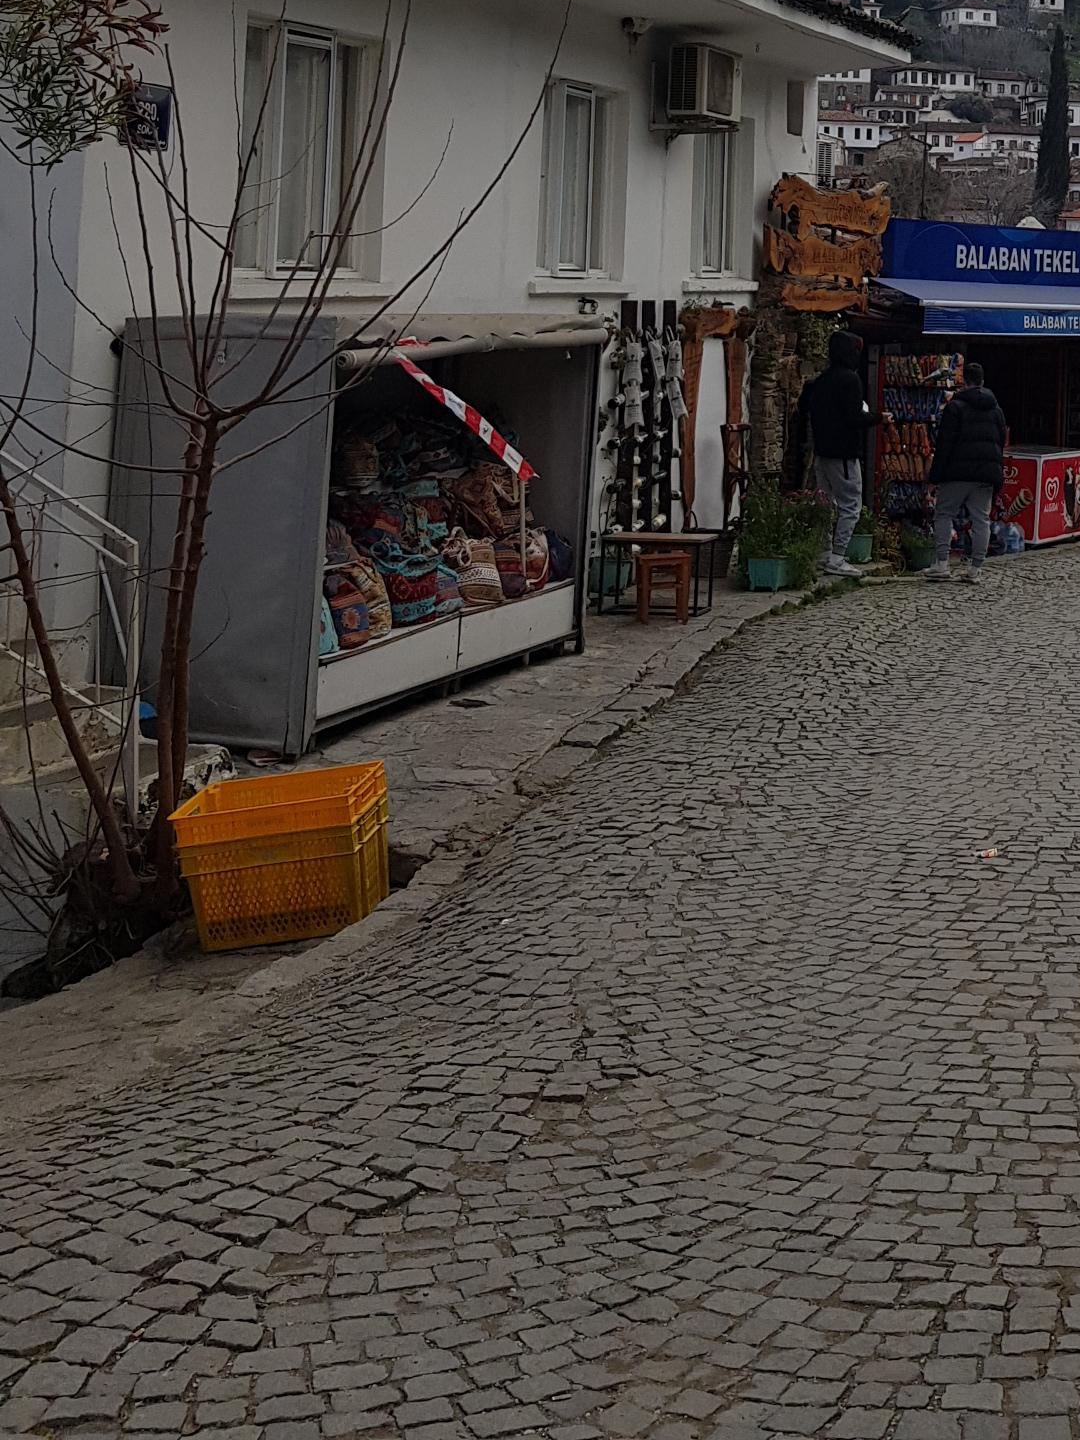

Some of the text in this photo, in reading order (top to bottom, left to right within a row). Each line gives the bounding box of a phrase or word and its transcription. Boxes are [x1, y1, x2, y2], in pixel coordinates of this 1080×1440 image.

[955, 244, 1080, 274] BALABAN TEKEL
[1023, 315, 1067, 329] BALABAN
